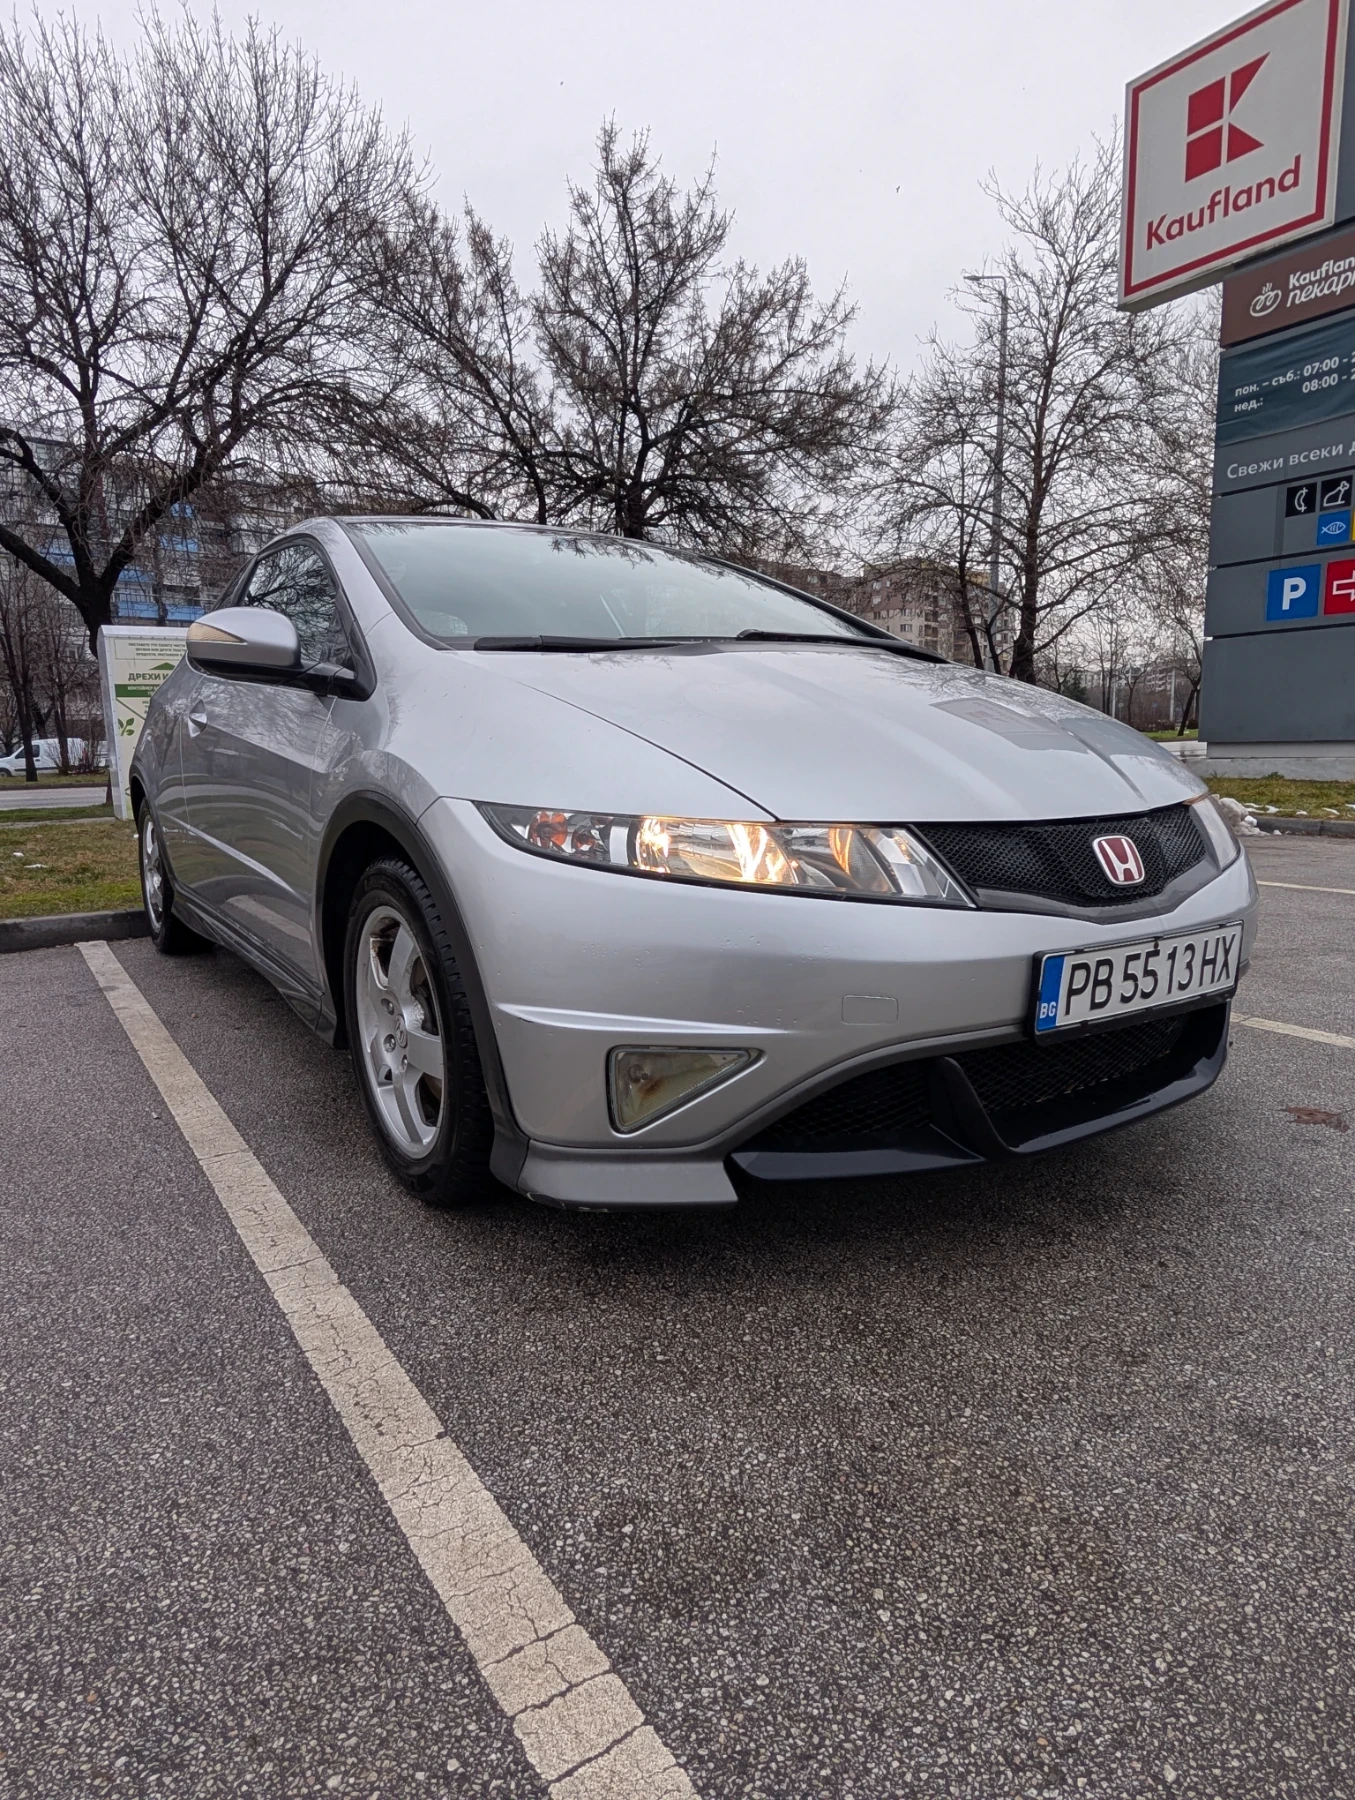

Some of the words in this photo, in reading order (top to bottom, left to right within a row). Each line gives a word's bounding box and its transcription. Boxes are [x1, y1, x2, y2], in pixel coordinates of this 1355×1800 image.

[1146, 153, 1301, 251] Kaufland
[1234, 397, 1263, 412] нед.:
[1302, 373, 1338, 393] 08:00
[1235, 384, 1260, 397] пон.
[1271, 369, 1300, 386] съб.:
[1303, 356, 1339, 376] 07:00
[1227, 457, 1283, 479] Свежи
[1289, 443, 1343, 465] всеки
[1282, 577, 1307, 611] P
[128, 672, 161, 682] ДРЕХИ
[1064, 957, 1114, 1016] PB
[1119, 942, 1196, 1004] 5513
[1198, 933, 1236, 987] HX
[1039, 1000, 1057, 1019] BG
